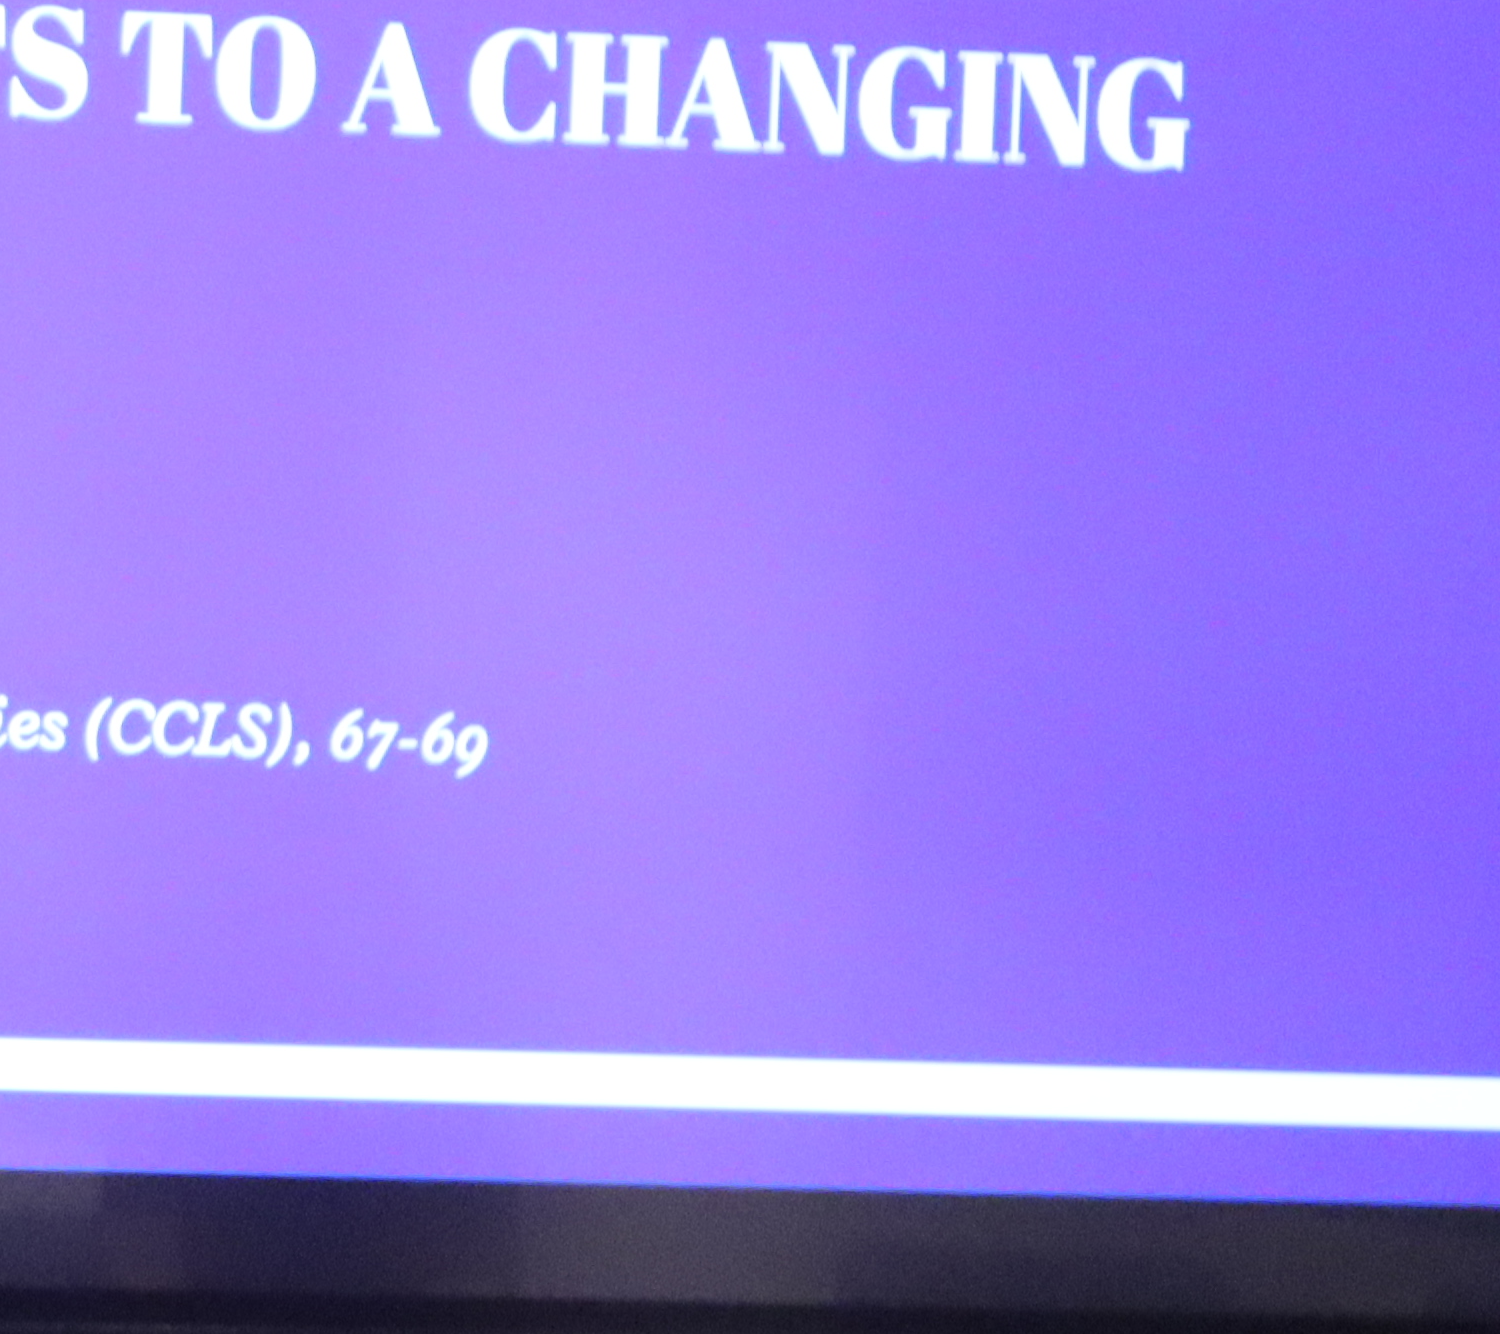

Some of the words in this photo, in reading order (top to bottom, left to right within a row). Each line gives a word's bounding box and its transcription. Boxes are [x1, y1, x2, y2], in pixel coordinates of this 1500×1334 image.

[120, 10, 316, 131] TO
[342, 22, 441, 137] A
[469, 28, 1189, 171] CHANGING
[84, 697, 310, 767] (CCLS),
[330, 709, 488, 778] 67-69
